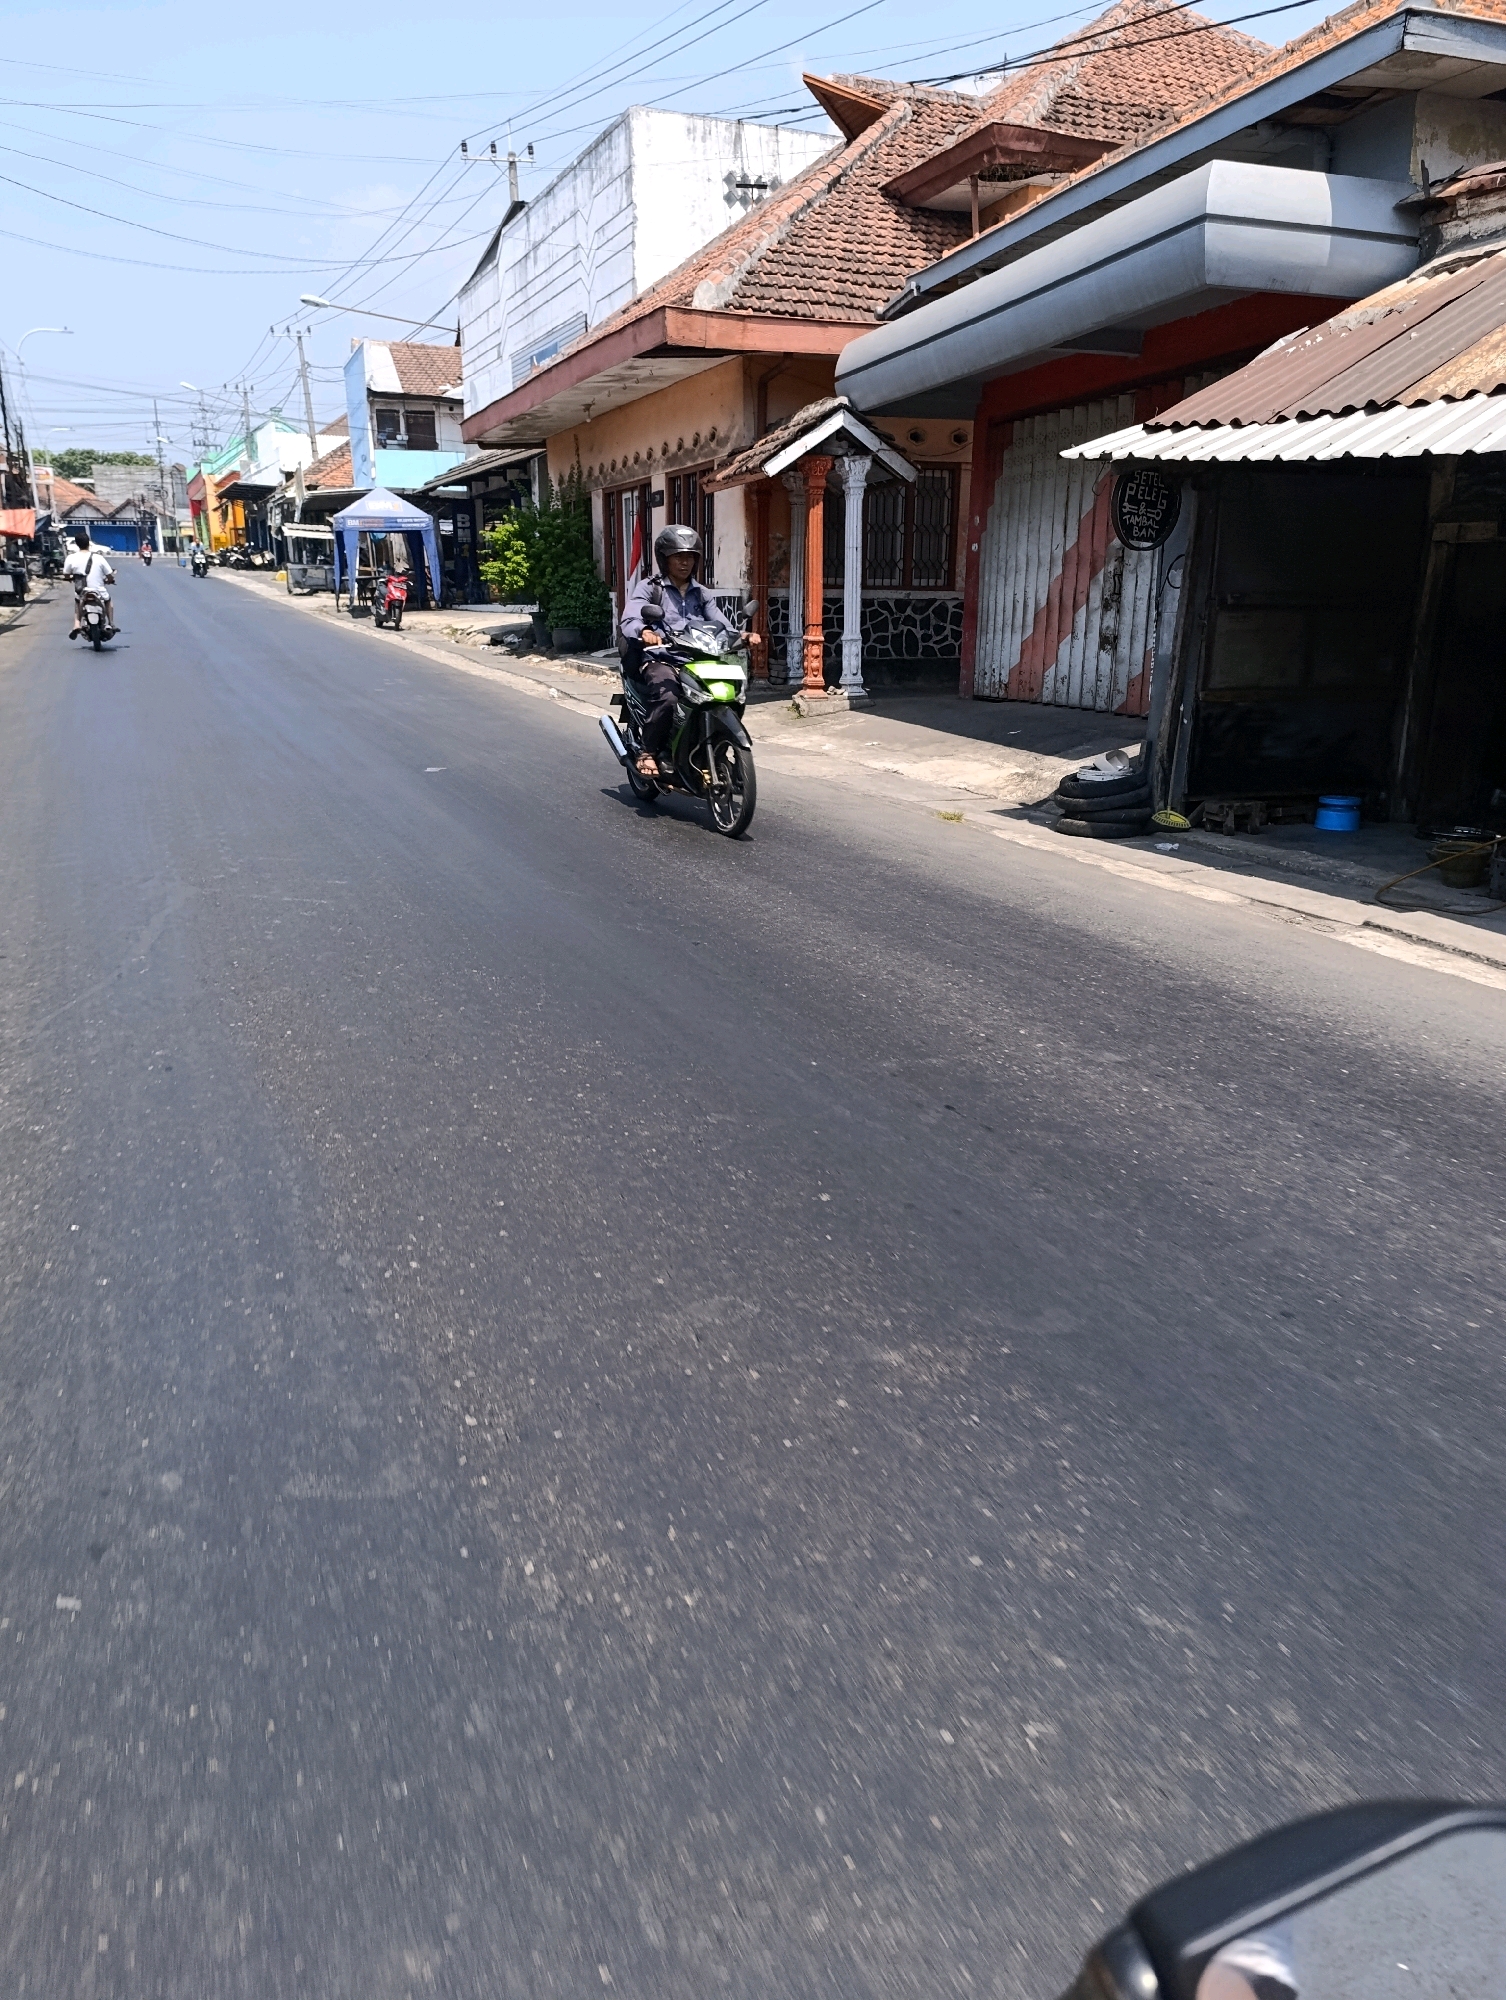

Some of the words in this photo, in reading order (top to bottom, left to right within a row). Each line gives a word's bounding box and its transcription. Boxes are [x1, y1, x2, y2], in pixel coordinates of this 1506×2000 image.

[1133, 470, 1165, 487] SETEL
[1124, 483, 1168, 510] PELEG
[1138, 502, 1147, 515] &
[1122, 514, 1160, 529] TAMBAL
[1132, 526, 1157, 538] BAN
